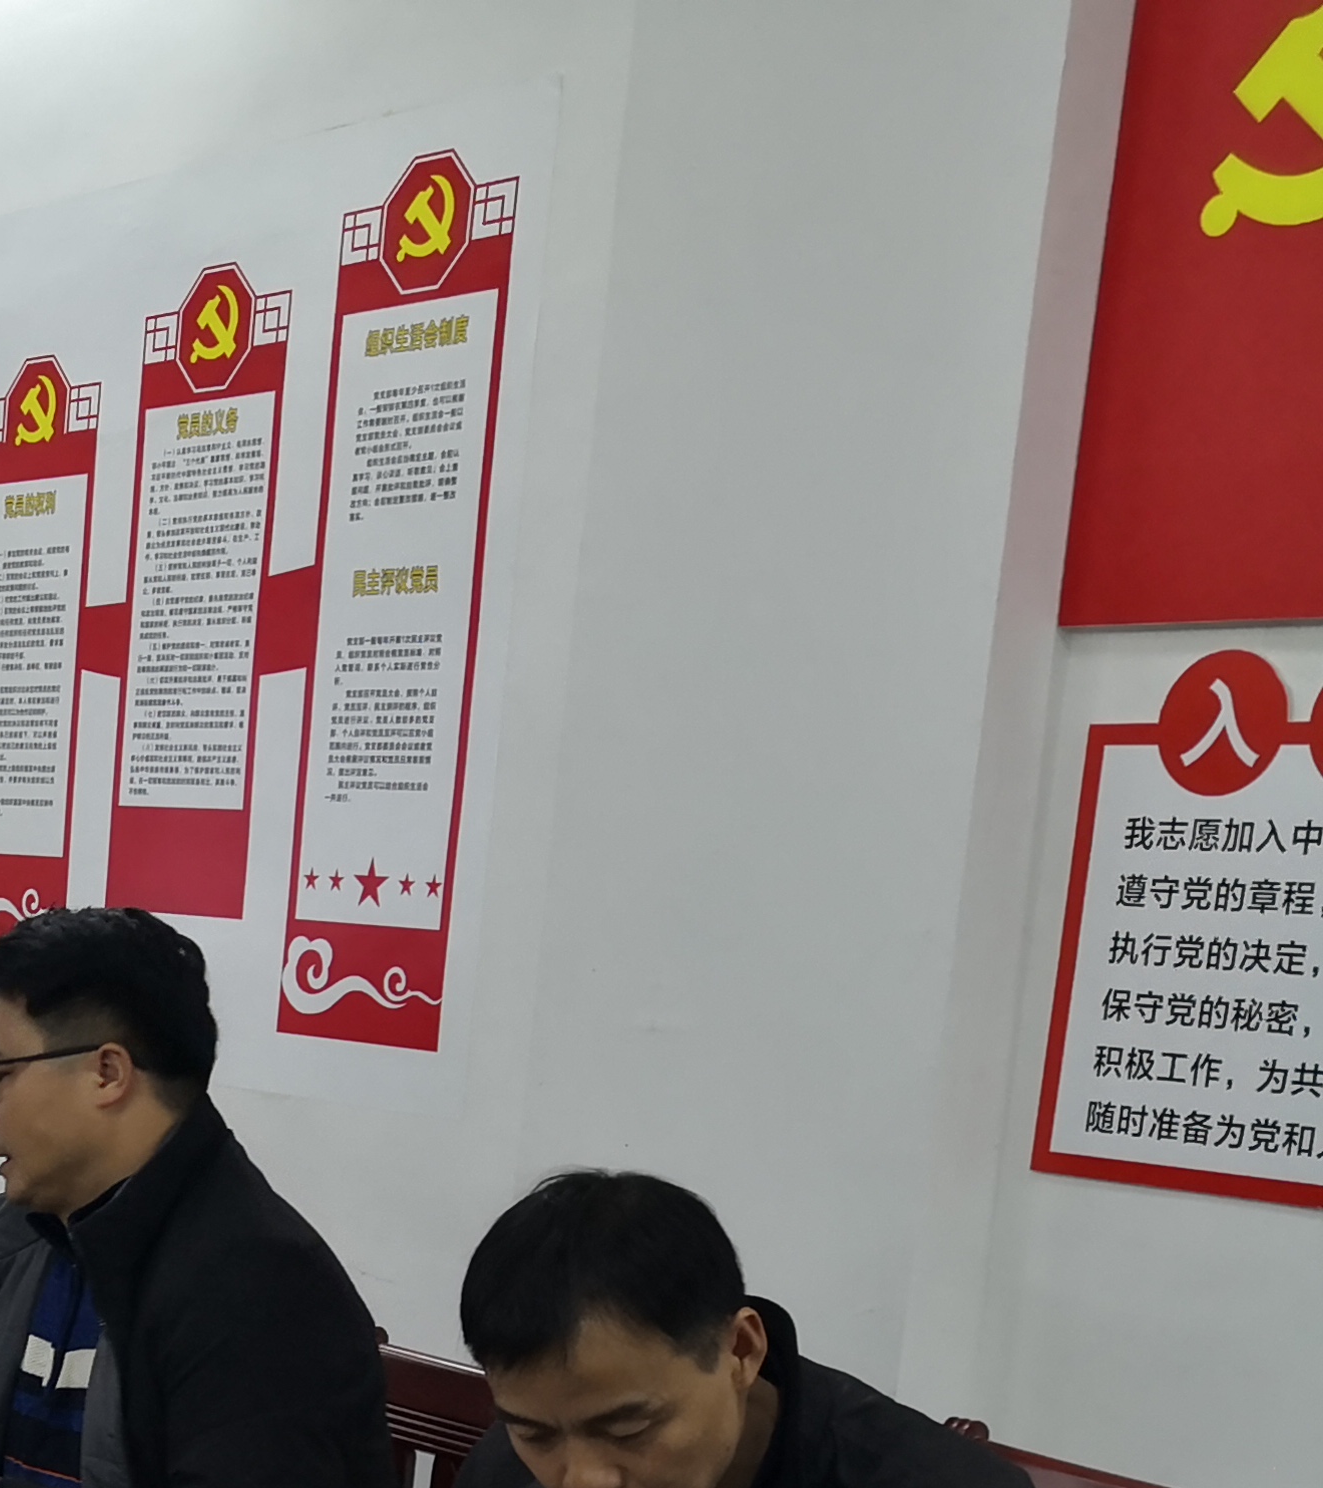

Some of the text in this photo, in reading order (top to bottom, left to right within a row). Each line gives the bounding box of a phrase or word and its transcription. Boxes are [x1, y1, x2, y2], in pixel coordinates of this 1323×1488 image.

[365, 314, 470, 357] 组织生活会制度
[352, 565, 438, 598] 民主评议党员
[1180, 678, 1260, 768] 入
[1124, 816, 1323, 856] 我志愿加入中
[1108, 931, 1320, 978] 执行党的决定，
[1101, 989, 1312, 1038] 保守党的秘密，
[1085, 1101, 1323, 1160] 随时准备为党和
